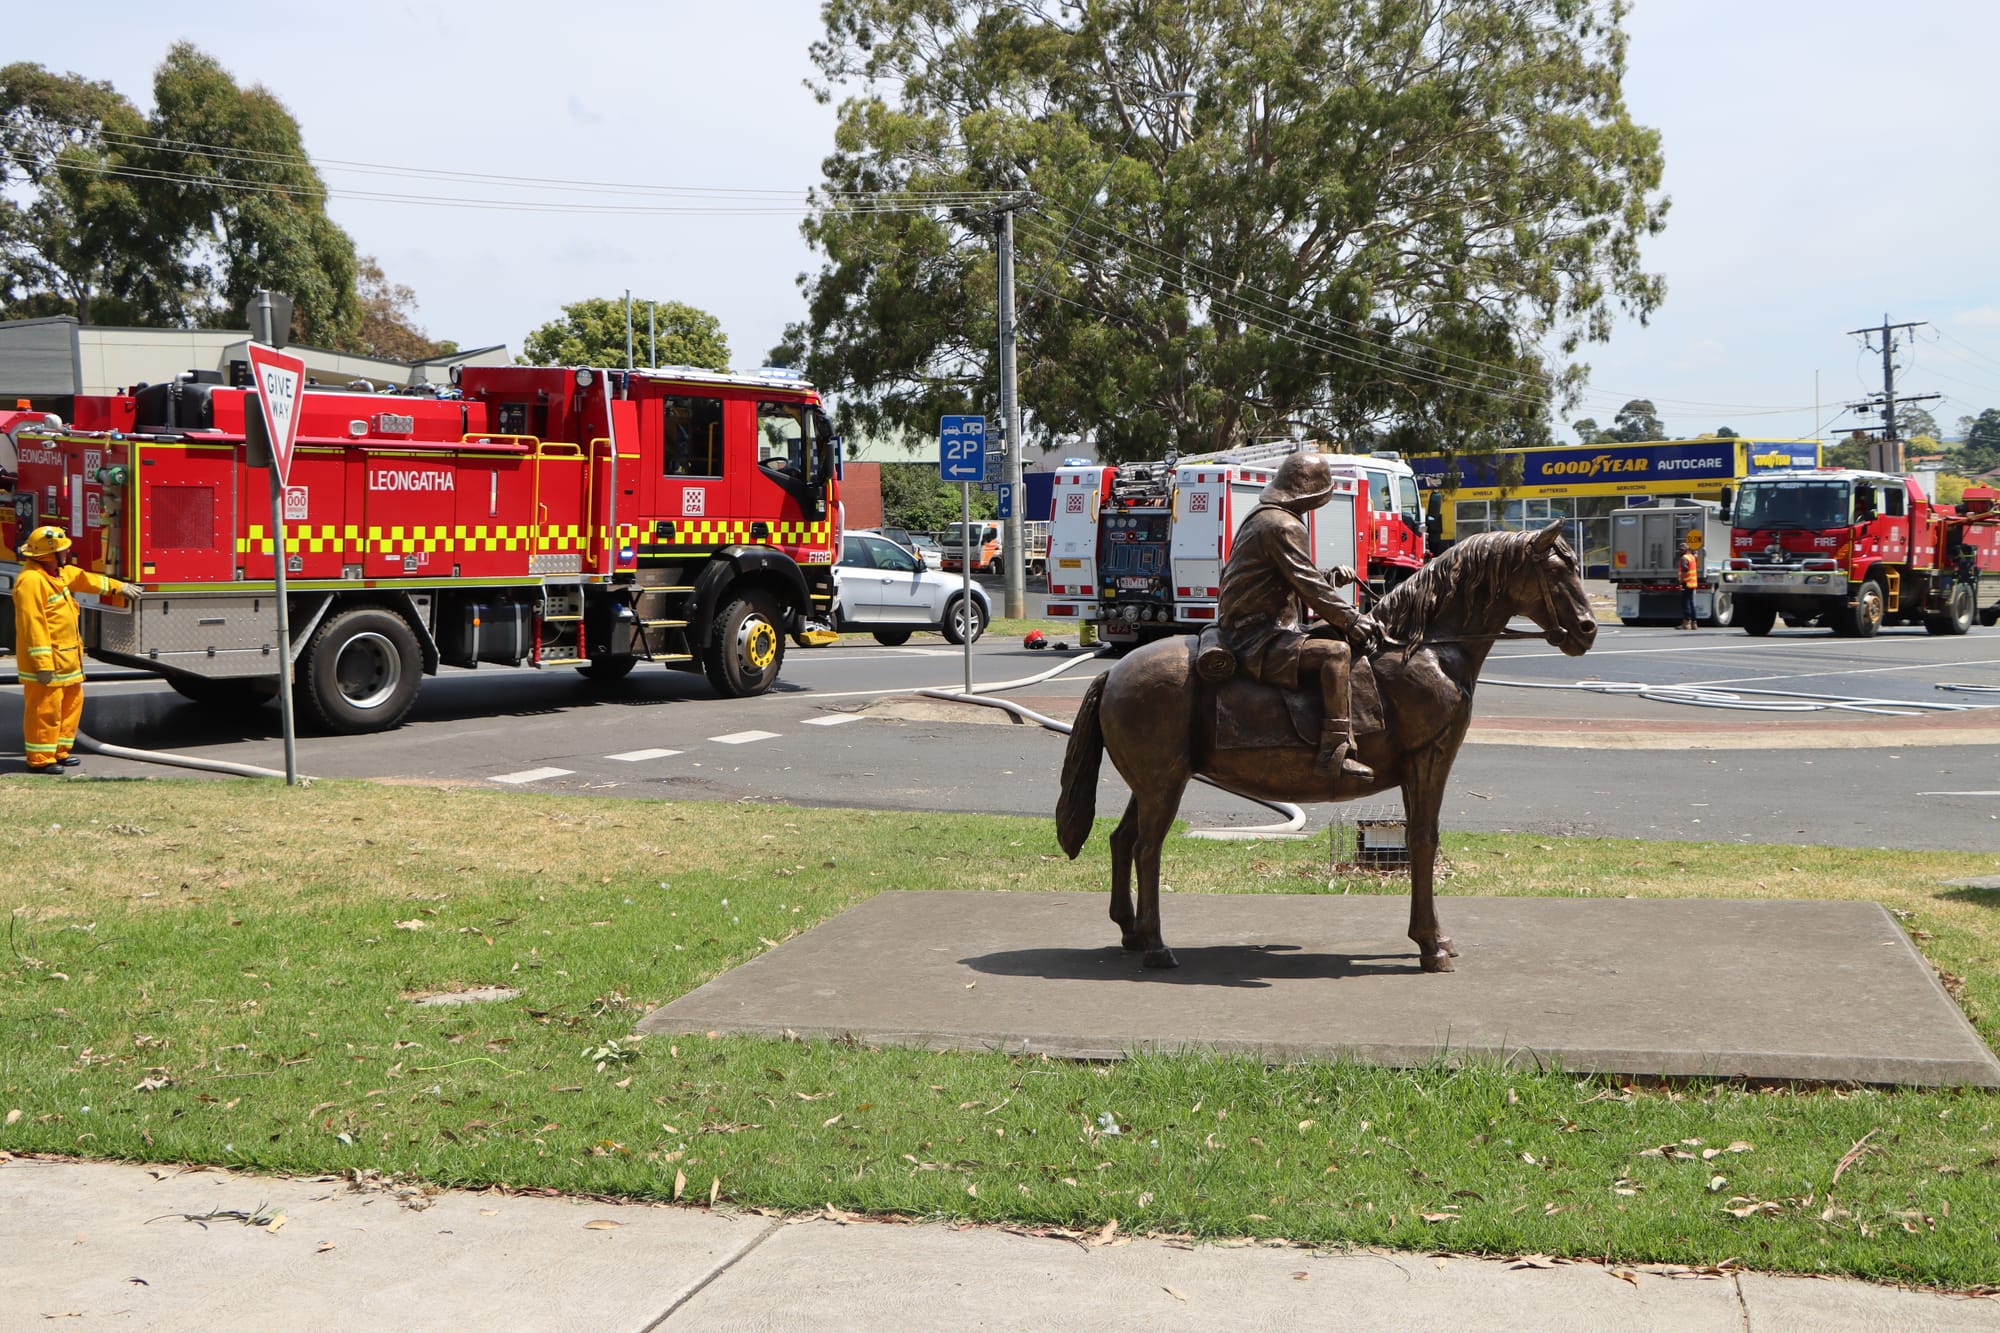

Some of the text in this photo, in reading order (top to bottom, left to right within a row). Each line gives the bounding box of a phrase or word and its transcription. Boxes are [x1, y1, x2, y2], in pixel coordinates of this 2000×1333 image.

[267, 372, 293, 399] GIVE
[272, 400, 289, 420] WAY
[17, 448, 64, 466] LEONGATHA
[947, 440, 978, 460] 2P
[1657, 457, 1723, 471] AUTOCARE
[369, 470, 455, 491] LEONGATHA
[287, 496, 307, 507] 000
[1000, 487, 1010, 504] P
[686, 504, 701, 513] CFA
[1192, 504, 1206, 512] CFA
[1814, 537, 1838, 547] FIRE
[808, 551, 831, 563] FIRE
[1109, 624, 1130, 634] CFA
